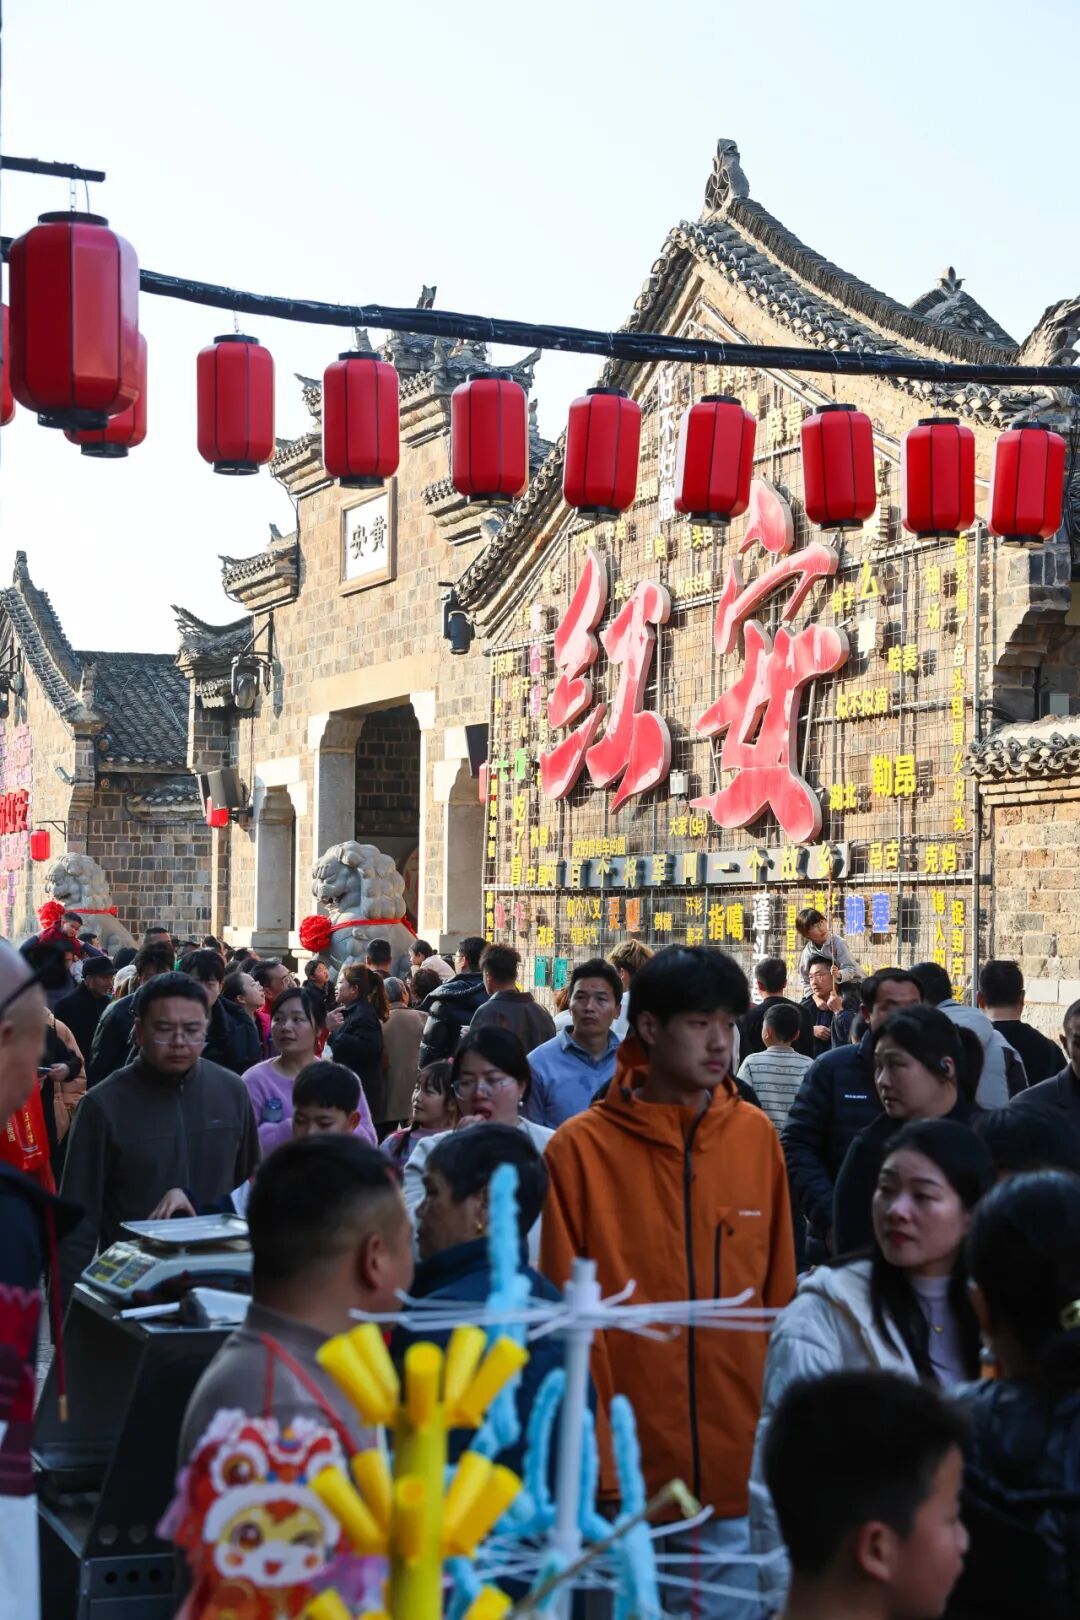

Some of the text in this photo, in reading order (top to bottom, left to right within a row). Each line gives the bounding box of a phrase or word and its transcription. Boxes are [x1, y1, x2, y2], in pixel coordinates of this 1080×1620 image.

[540, 475, 850, 846] 红安
[873, 754, 917, 798] 勒昂
[829, 782, 857, 811] 湖北
[669, 814, 708, 838] 大家(ga)
